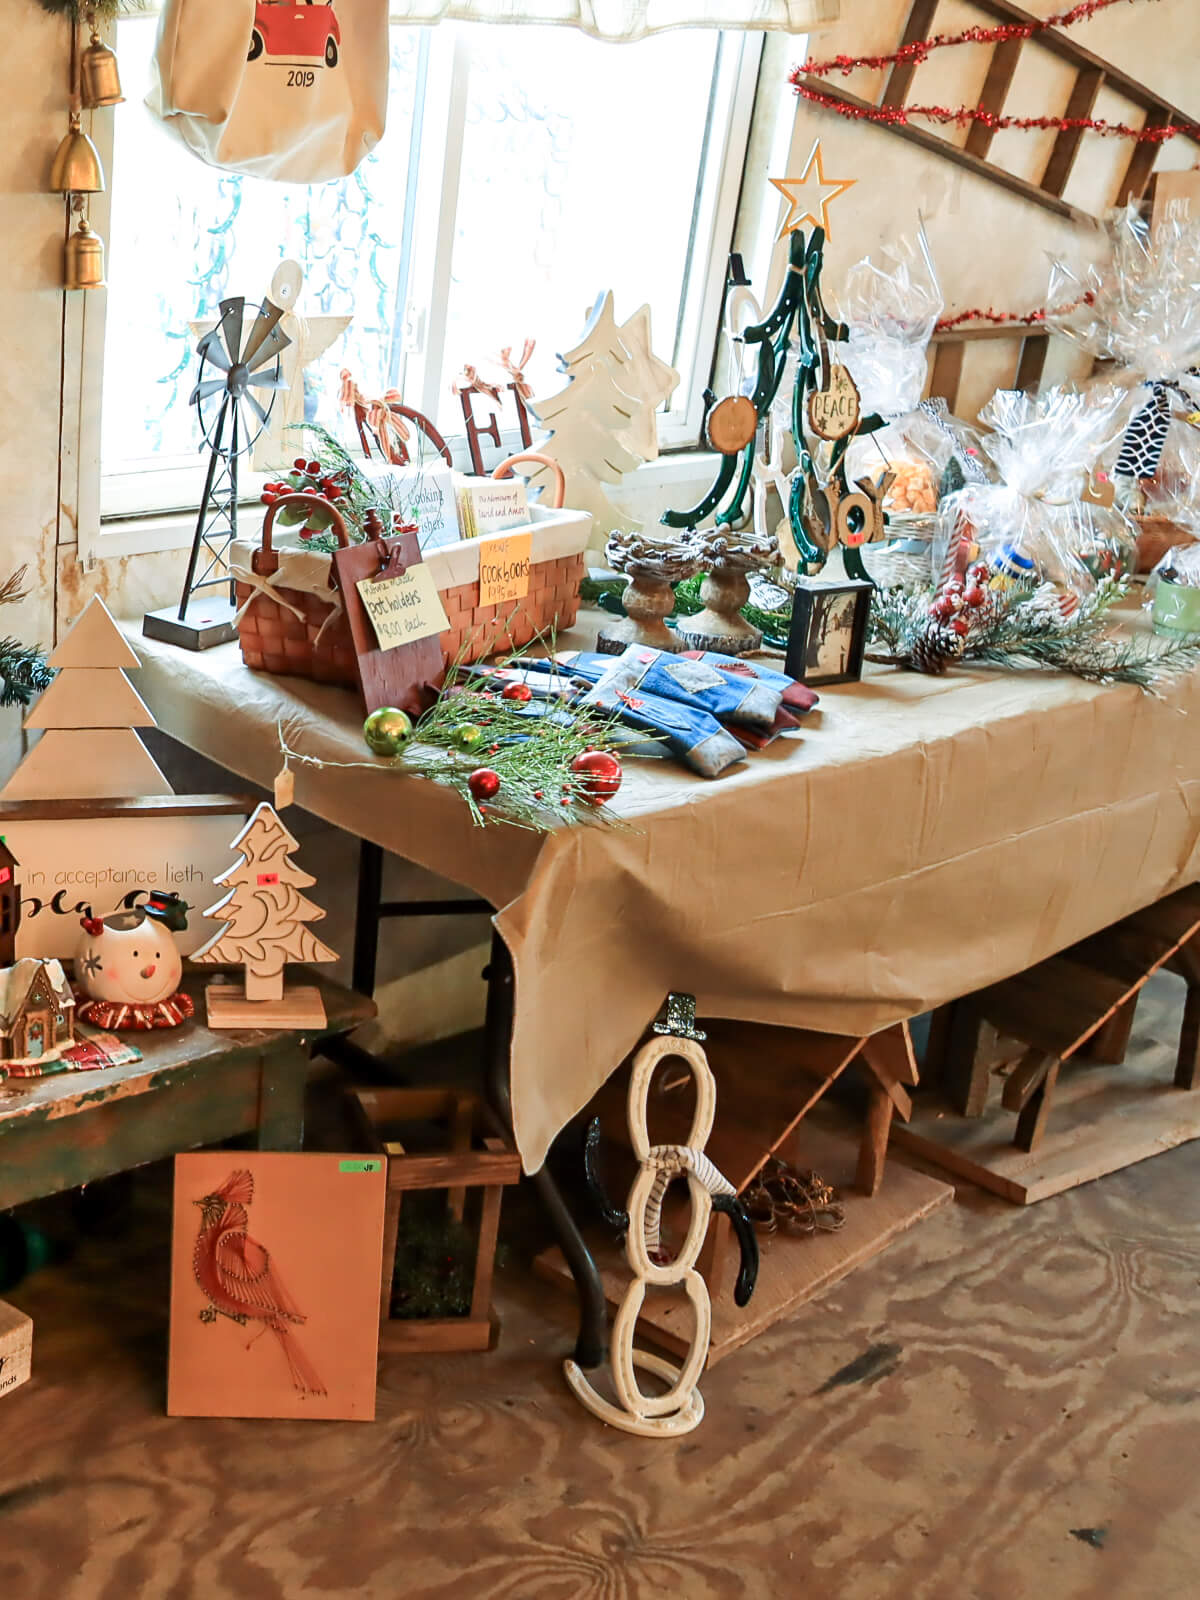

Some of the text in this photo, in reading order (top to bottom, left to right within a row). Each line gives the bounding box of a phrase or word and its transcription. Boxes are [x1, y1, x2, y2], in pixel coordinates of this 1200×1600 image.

[287, 71, 315, 87] 2019
[814, 395, 855, 418] PEACE
[366, 590, 421, 621] pot holders
[27, 862, 204, 888] in acceptance lieth
